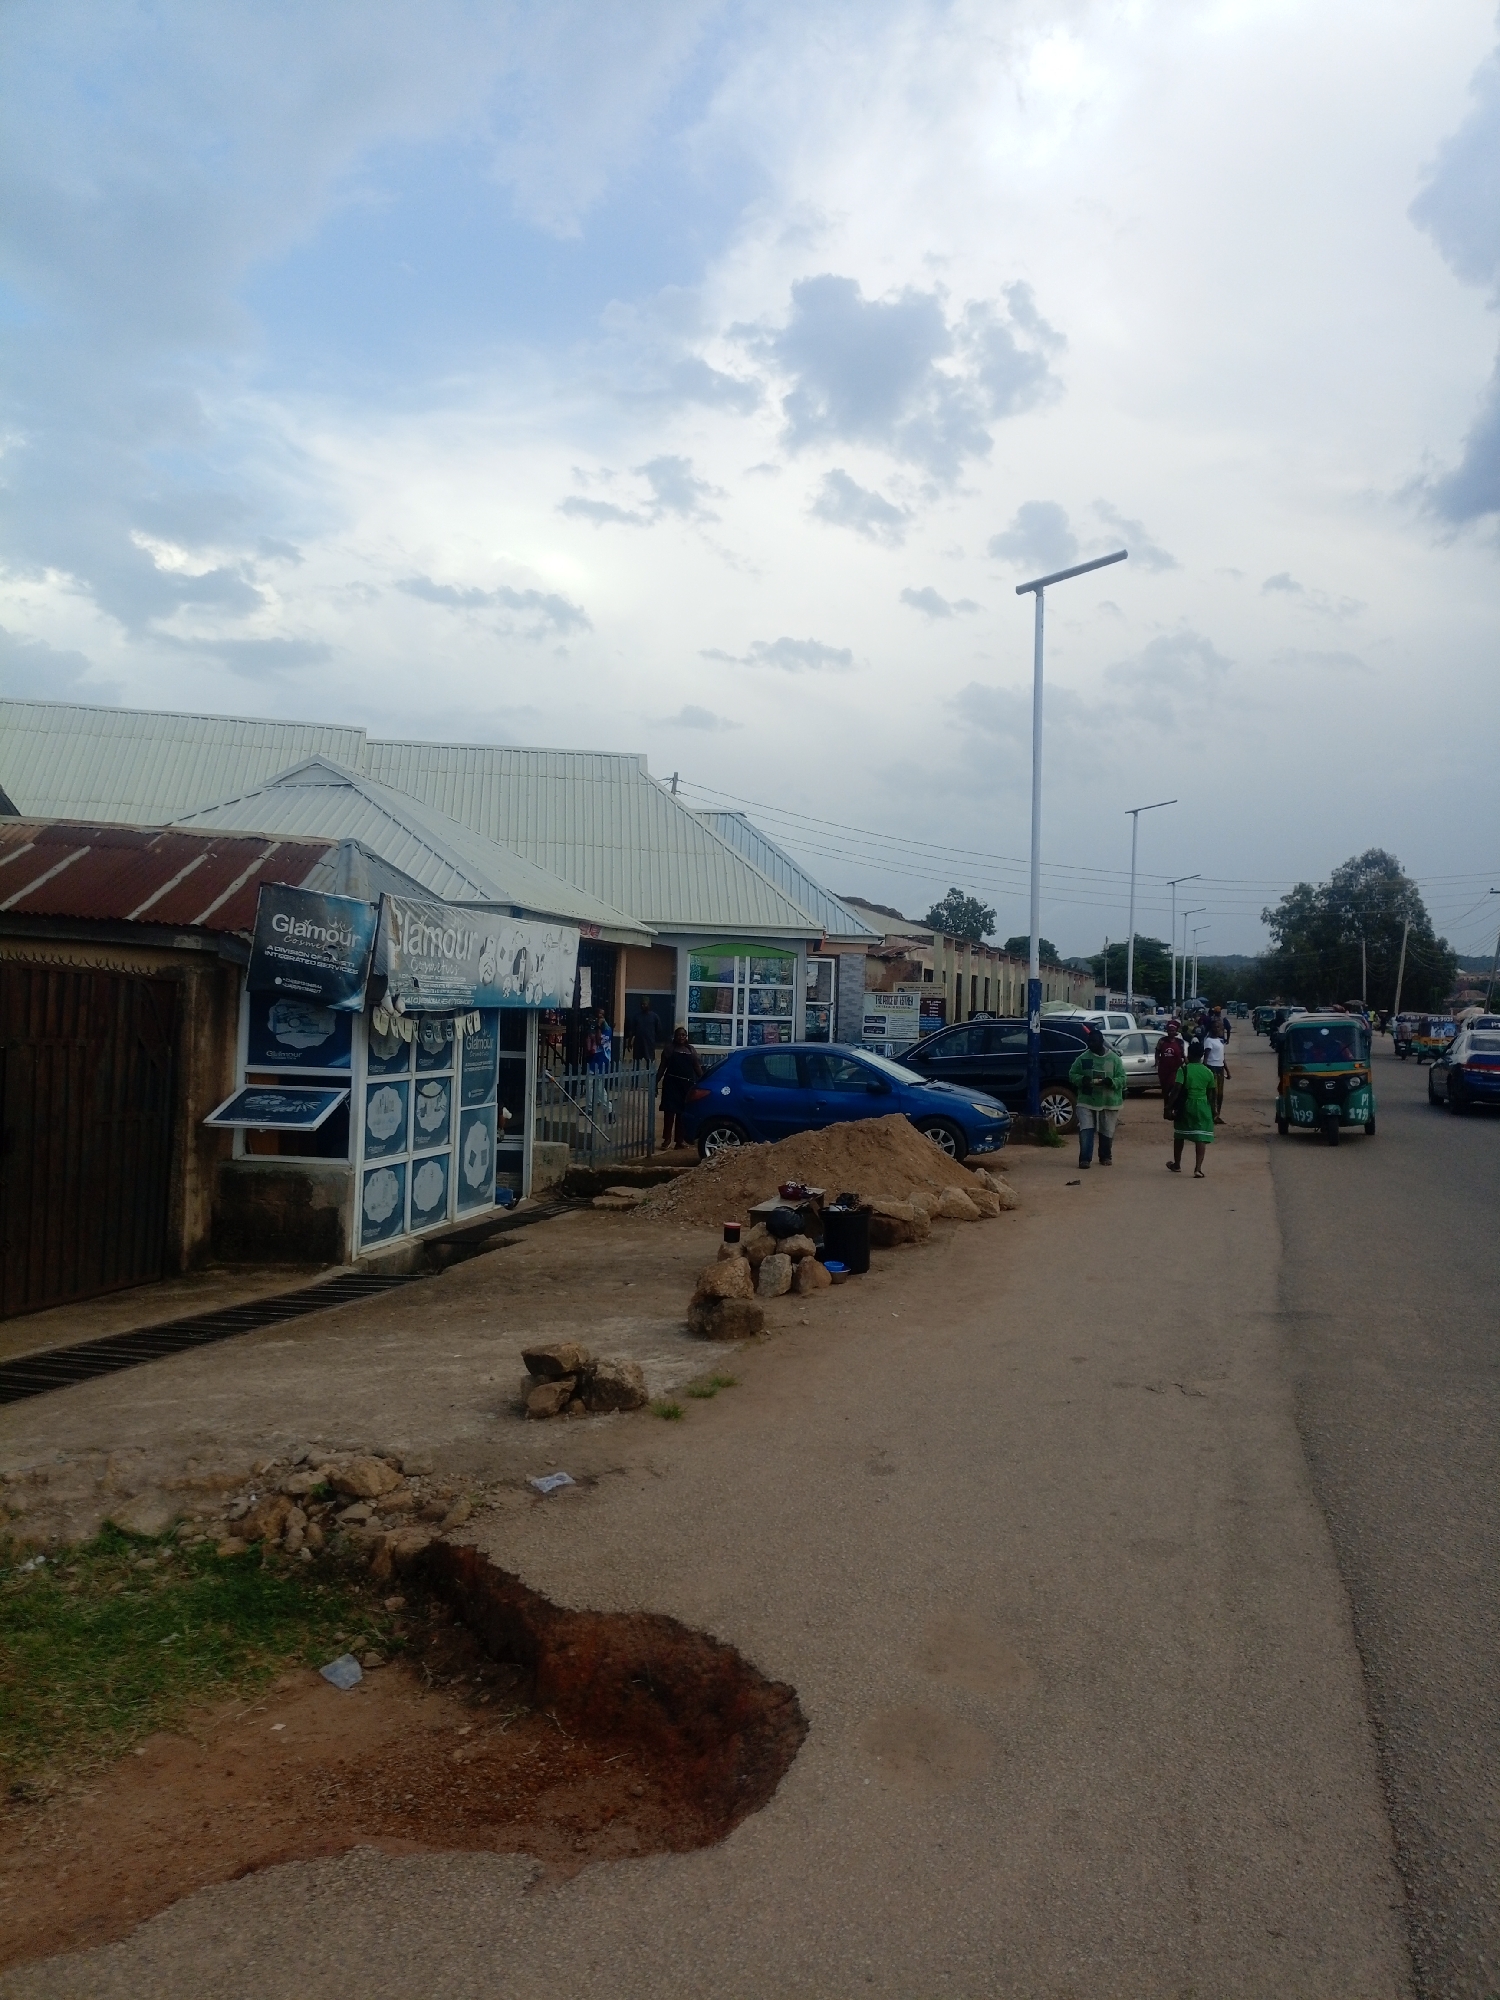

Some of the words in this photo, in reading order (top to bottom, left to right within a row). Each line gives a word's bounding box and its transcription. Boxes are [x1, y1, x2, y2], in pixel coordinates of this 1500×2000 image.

[271, 913, 362, 948] Glamour
[274, 946, 310, 958] DIVISION
[264, 950, 317, 966] INTEGRATED
[316, 961, 359, 975] SERVICES
[465, 1035, 494, 1051] Glamour
